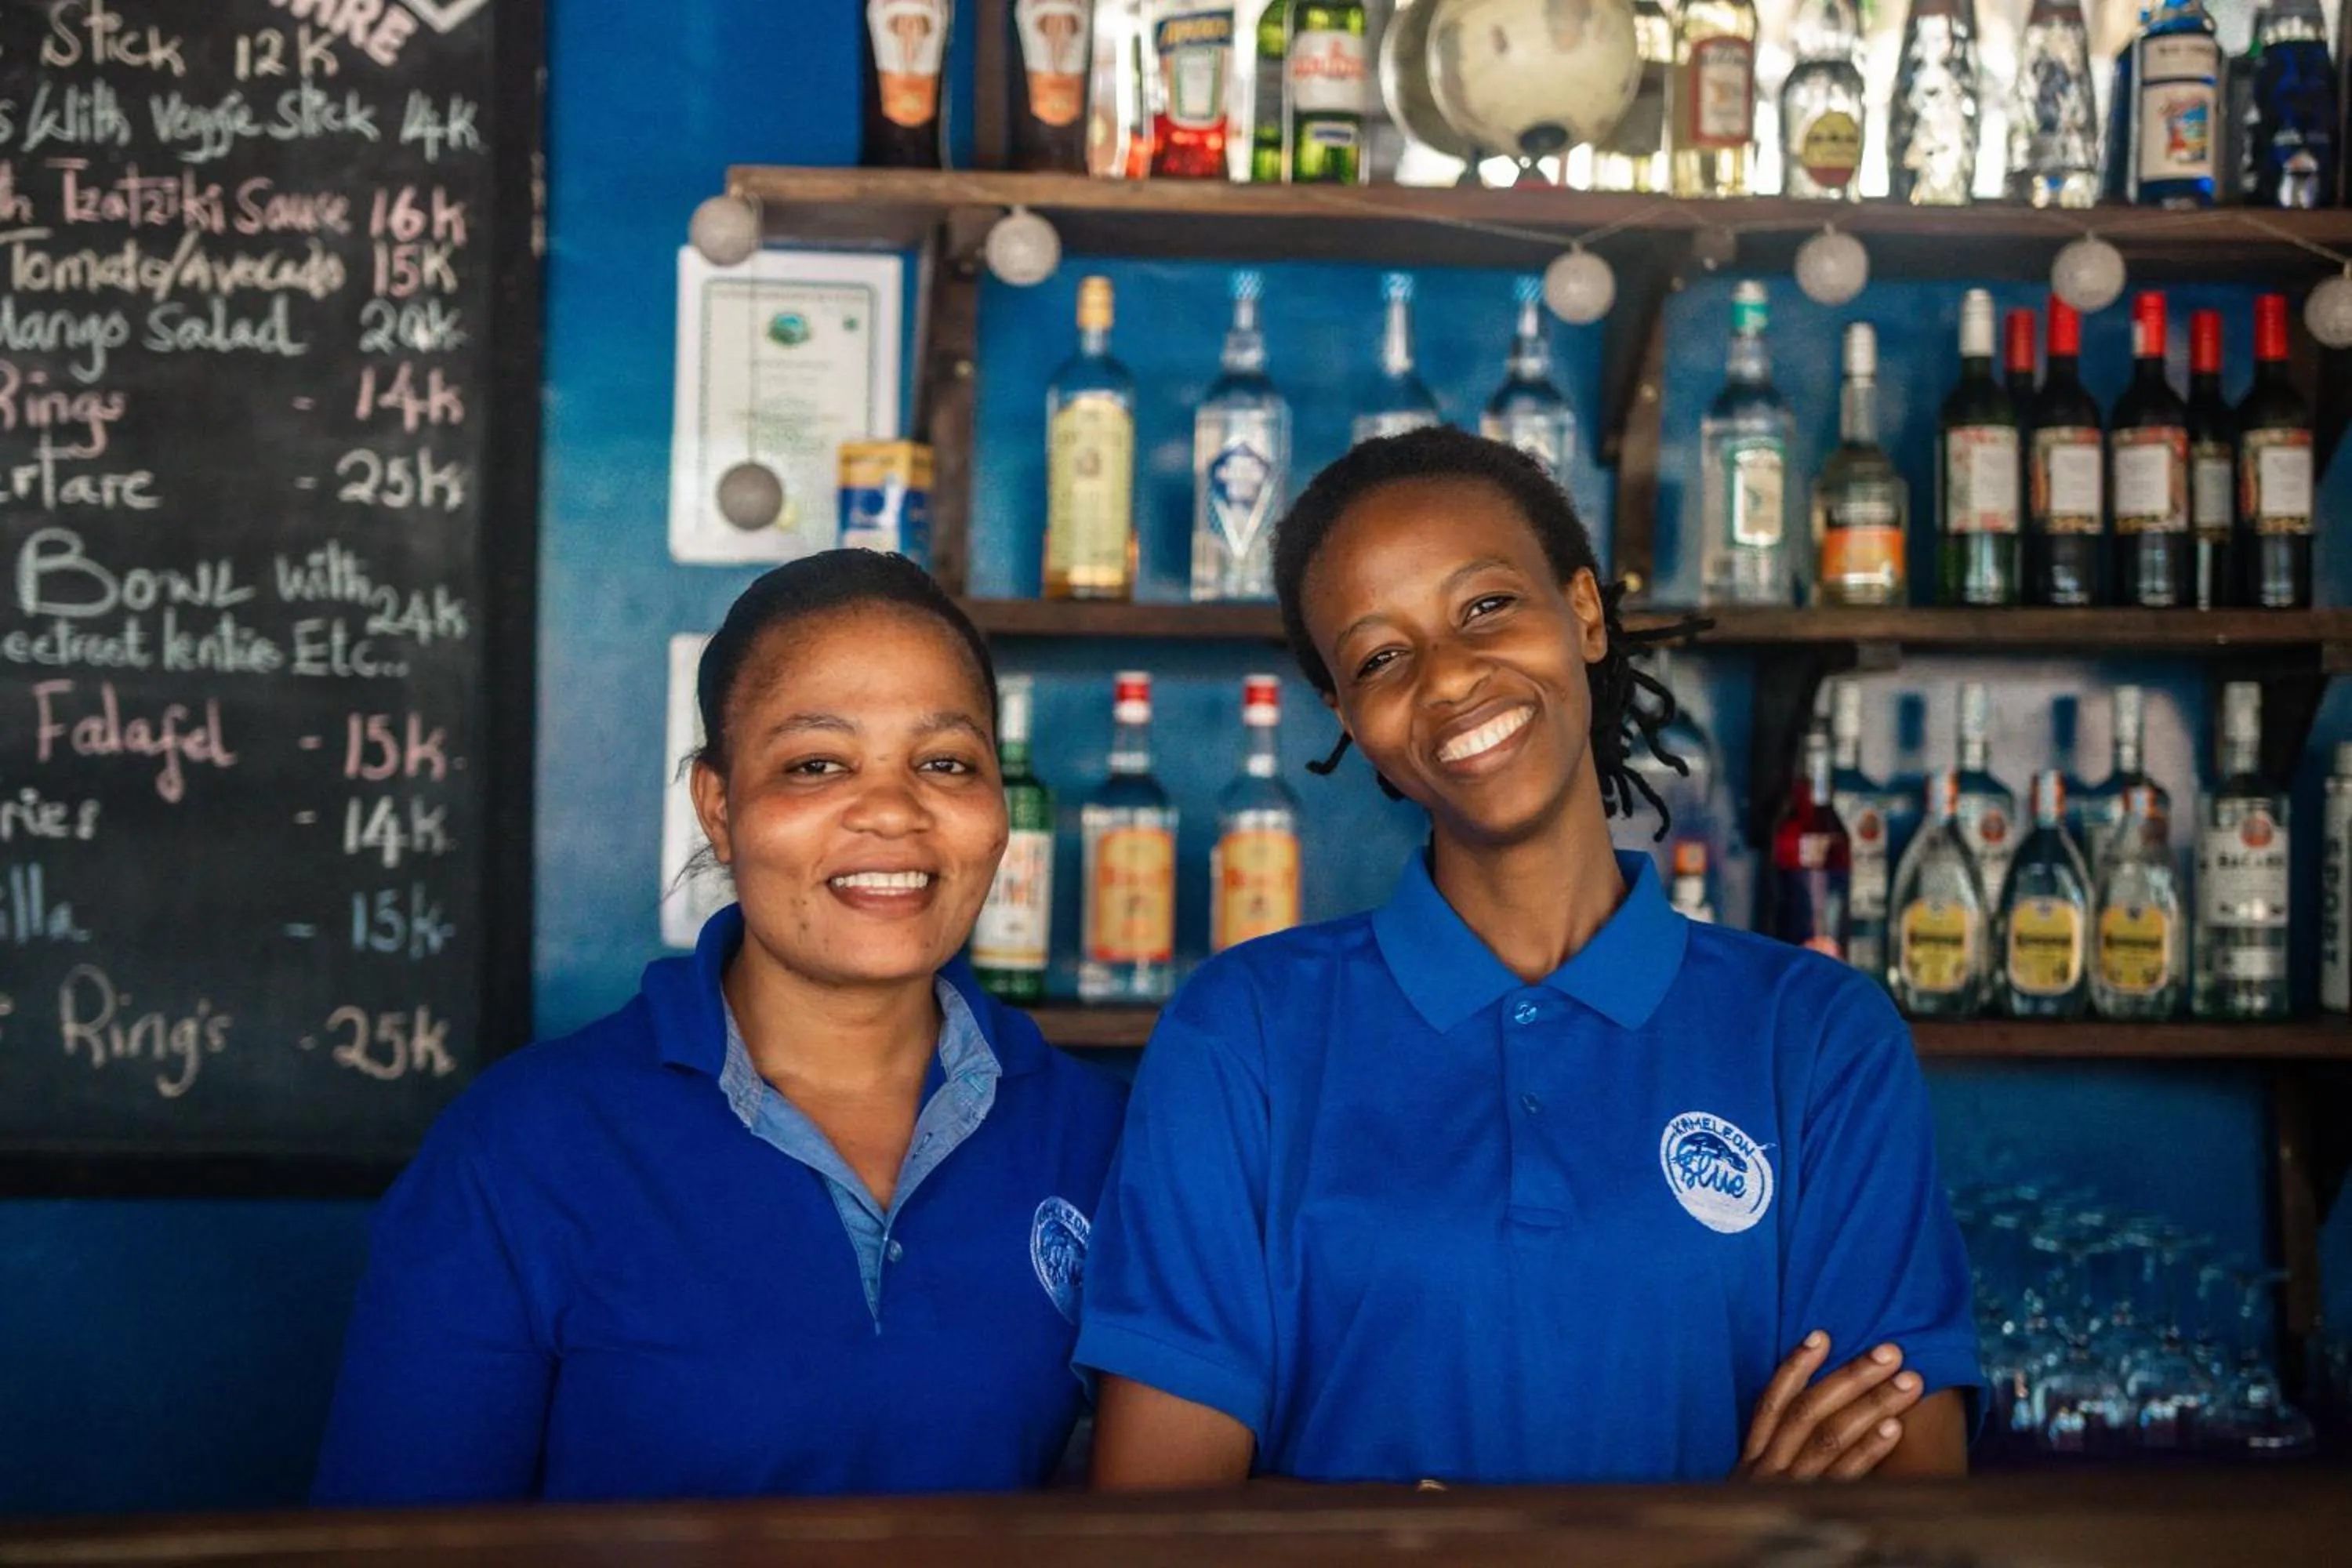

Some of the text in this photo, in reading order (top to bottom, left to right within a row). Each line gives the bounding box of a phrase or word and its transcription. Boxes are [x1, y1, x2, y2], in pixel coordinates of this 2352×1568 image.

[41, 0, 187, 77] Stick
[141, 294, 309, 357] Salad
[32, 677, 238, 804] Falafel
[1670, 1115, 1756, 1159] KAMELEON
